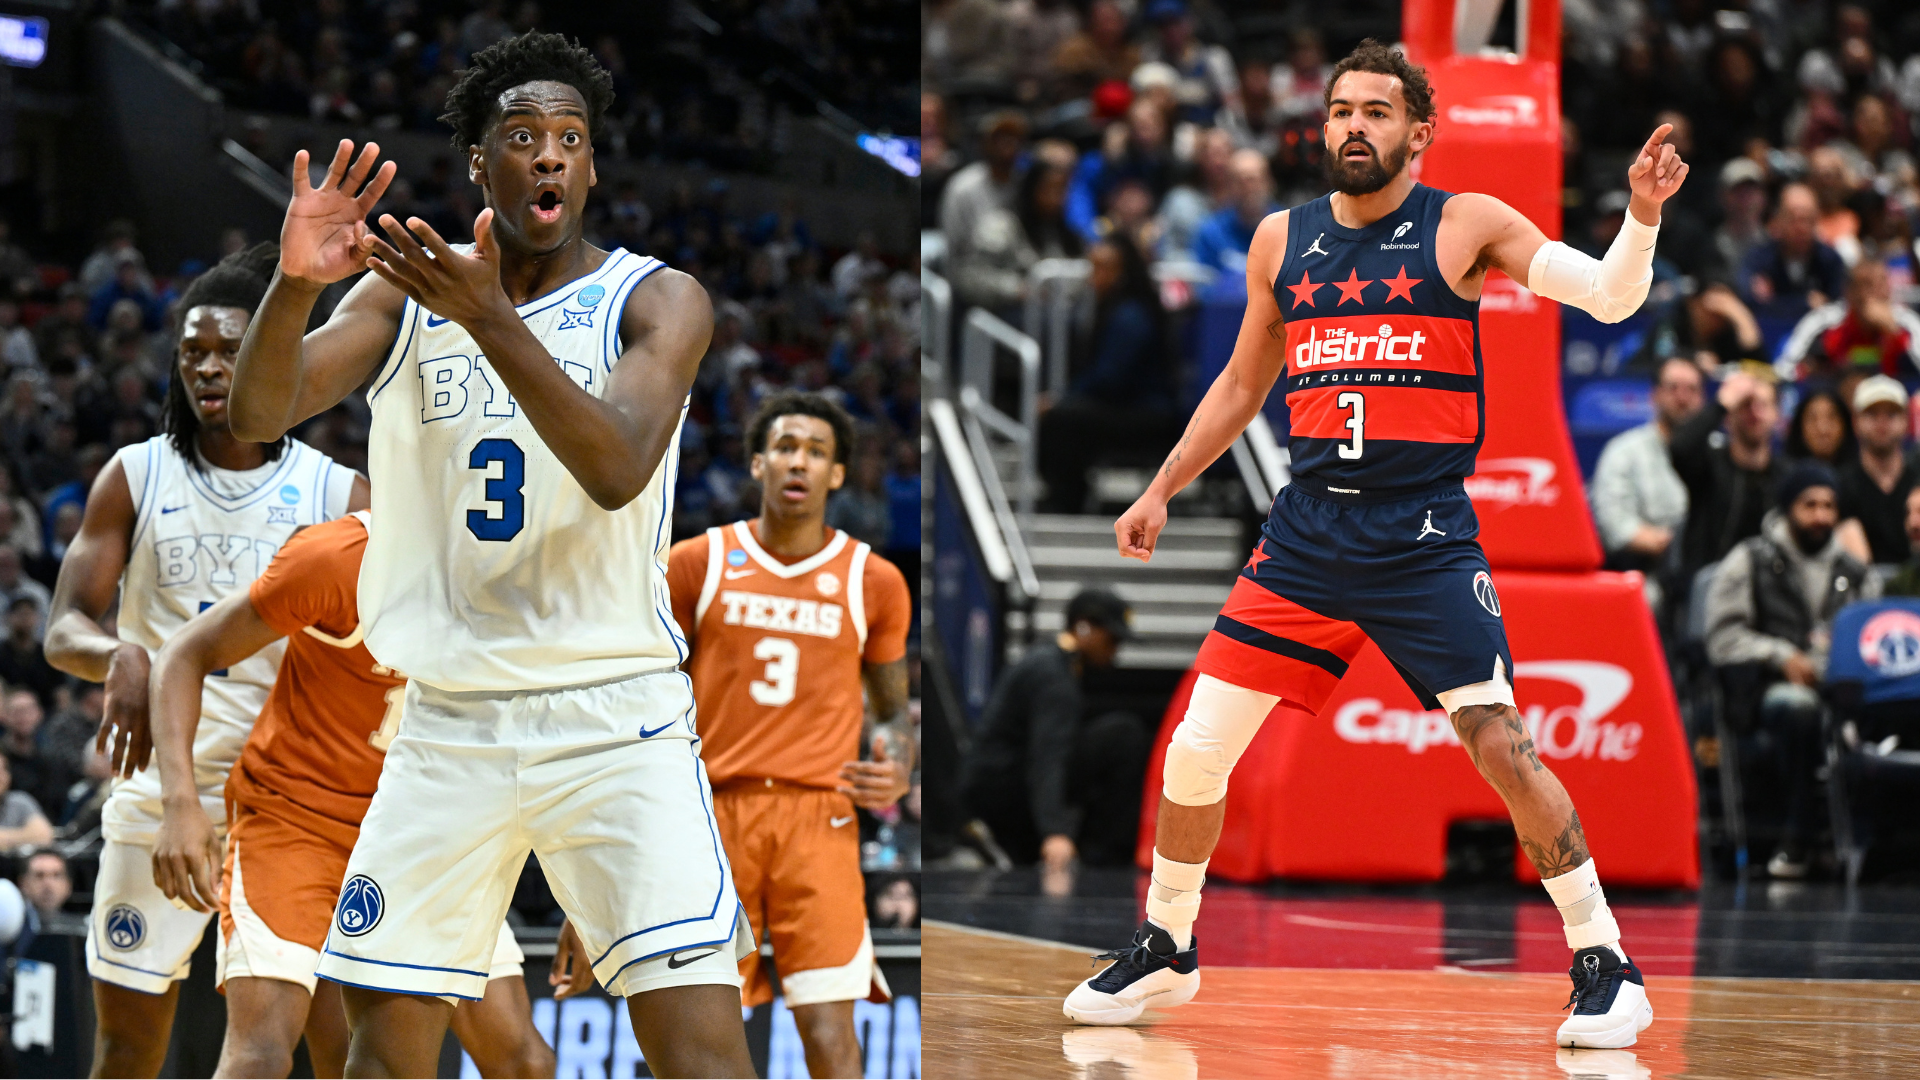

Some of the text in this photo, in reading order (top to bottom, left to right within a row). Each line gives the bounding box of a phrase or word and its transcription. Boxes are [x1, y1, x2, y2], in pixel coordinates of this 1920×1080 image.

[1380, 242, 1420, 251] Robinhood
[1295, 324, 1426, 368] district
[1324, 327, 1347, 338] THE
[1320, 373, 1422, 383] COLUMBIA
[1336, 390, 1366, 461] 3
[466, 438, 525, 542] 3
[721, 590, 843, 639] TEXAS
[749, 636, 800, 708] 3
[1333, 698, 1644, 763] Capl One
